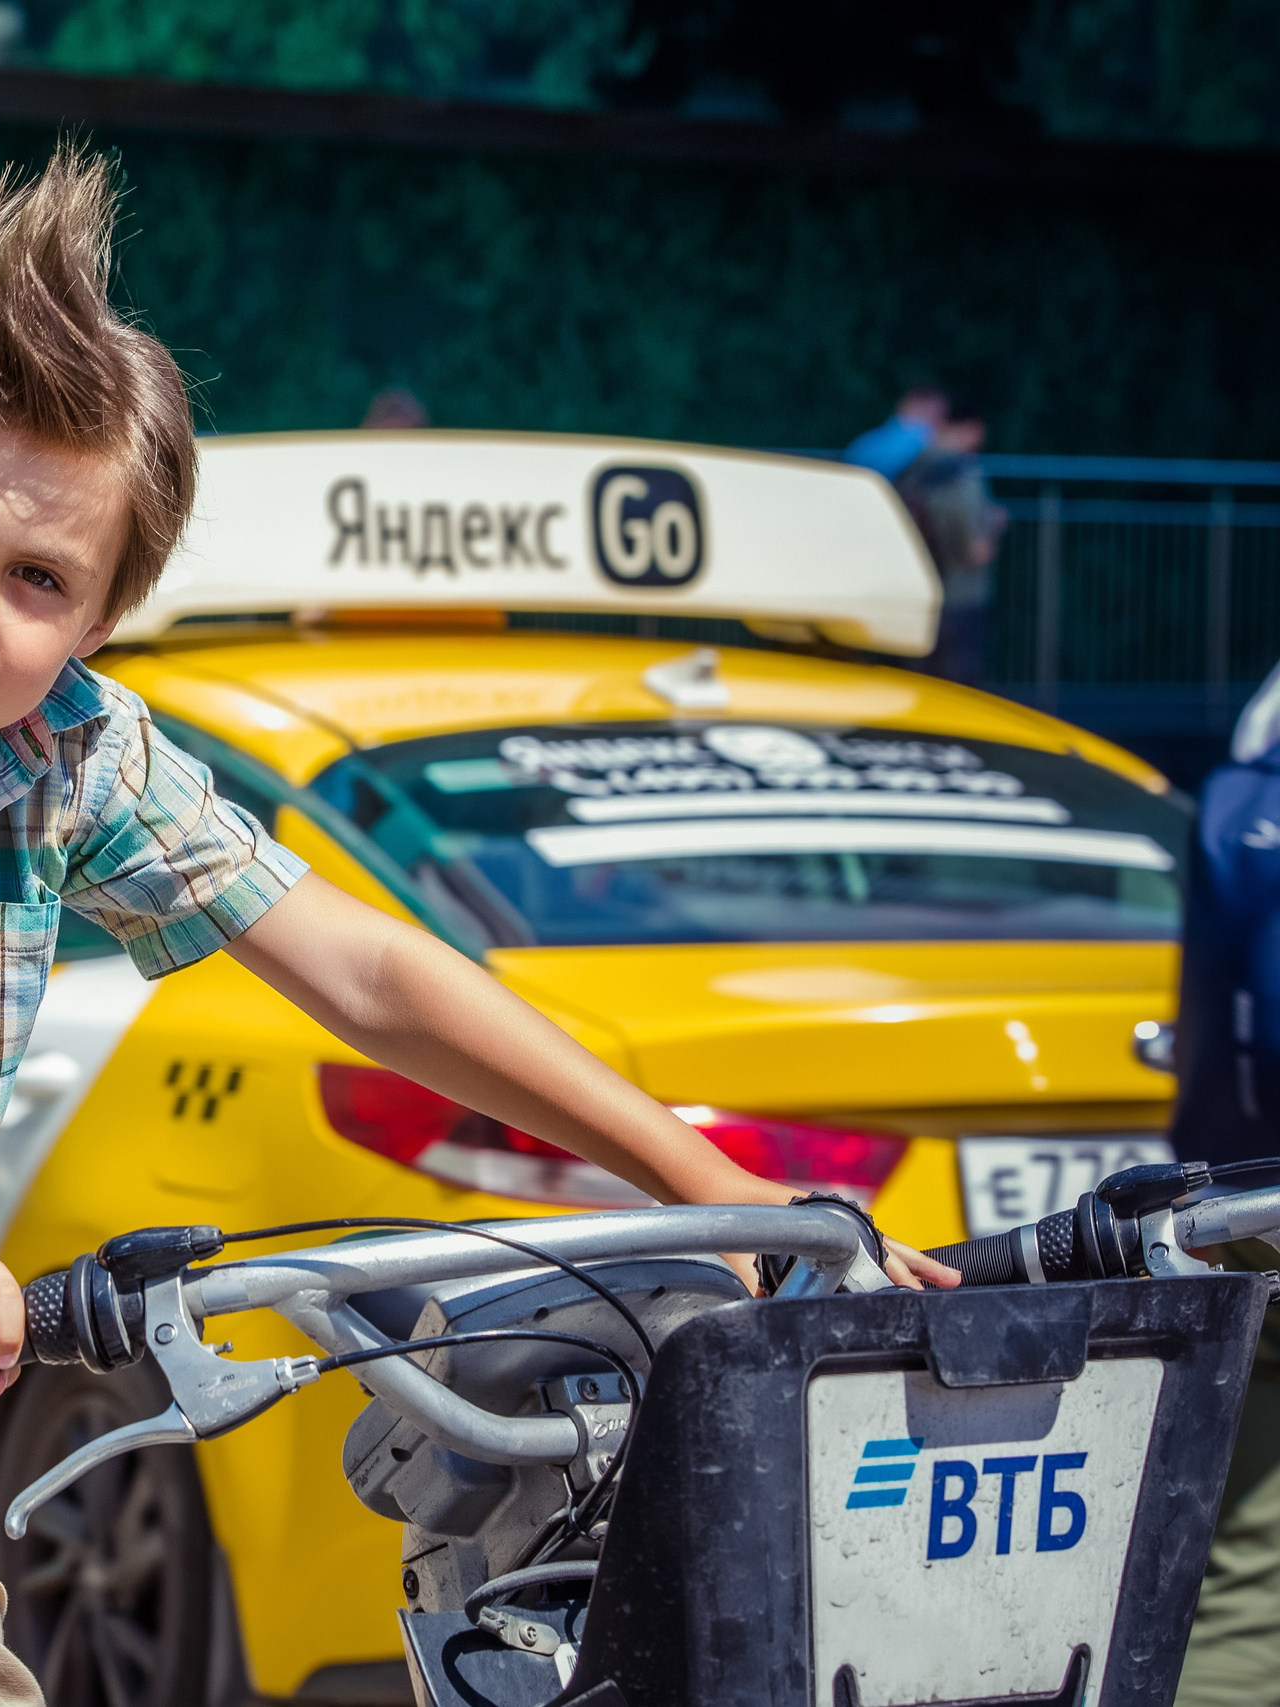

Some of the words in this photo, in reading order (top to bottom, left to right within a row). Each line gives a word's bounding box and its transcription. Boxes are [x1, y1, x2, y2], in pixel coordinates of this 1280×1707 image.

[325, 475, 568, 575] Яндекс
[599, 473, 699, 580] Go
[926, 1452, 1088, 1560] ВТБ
